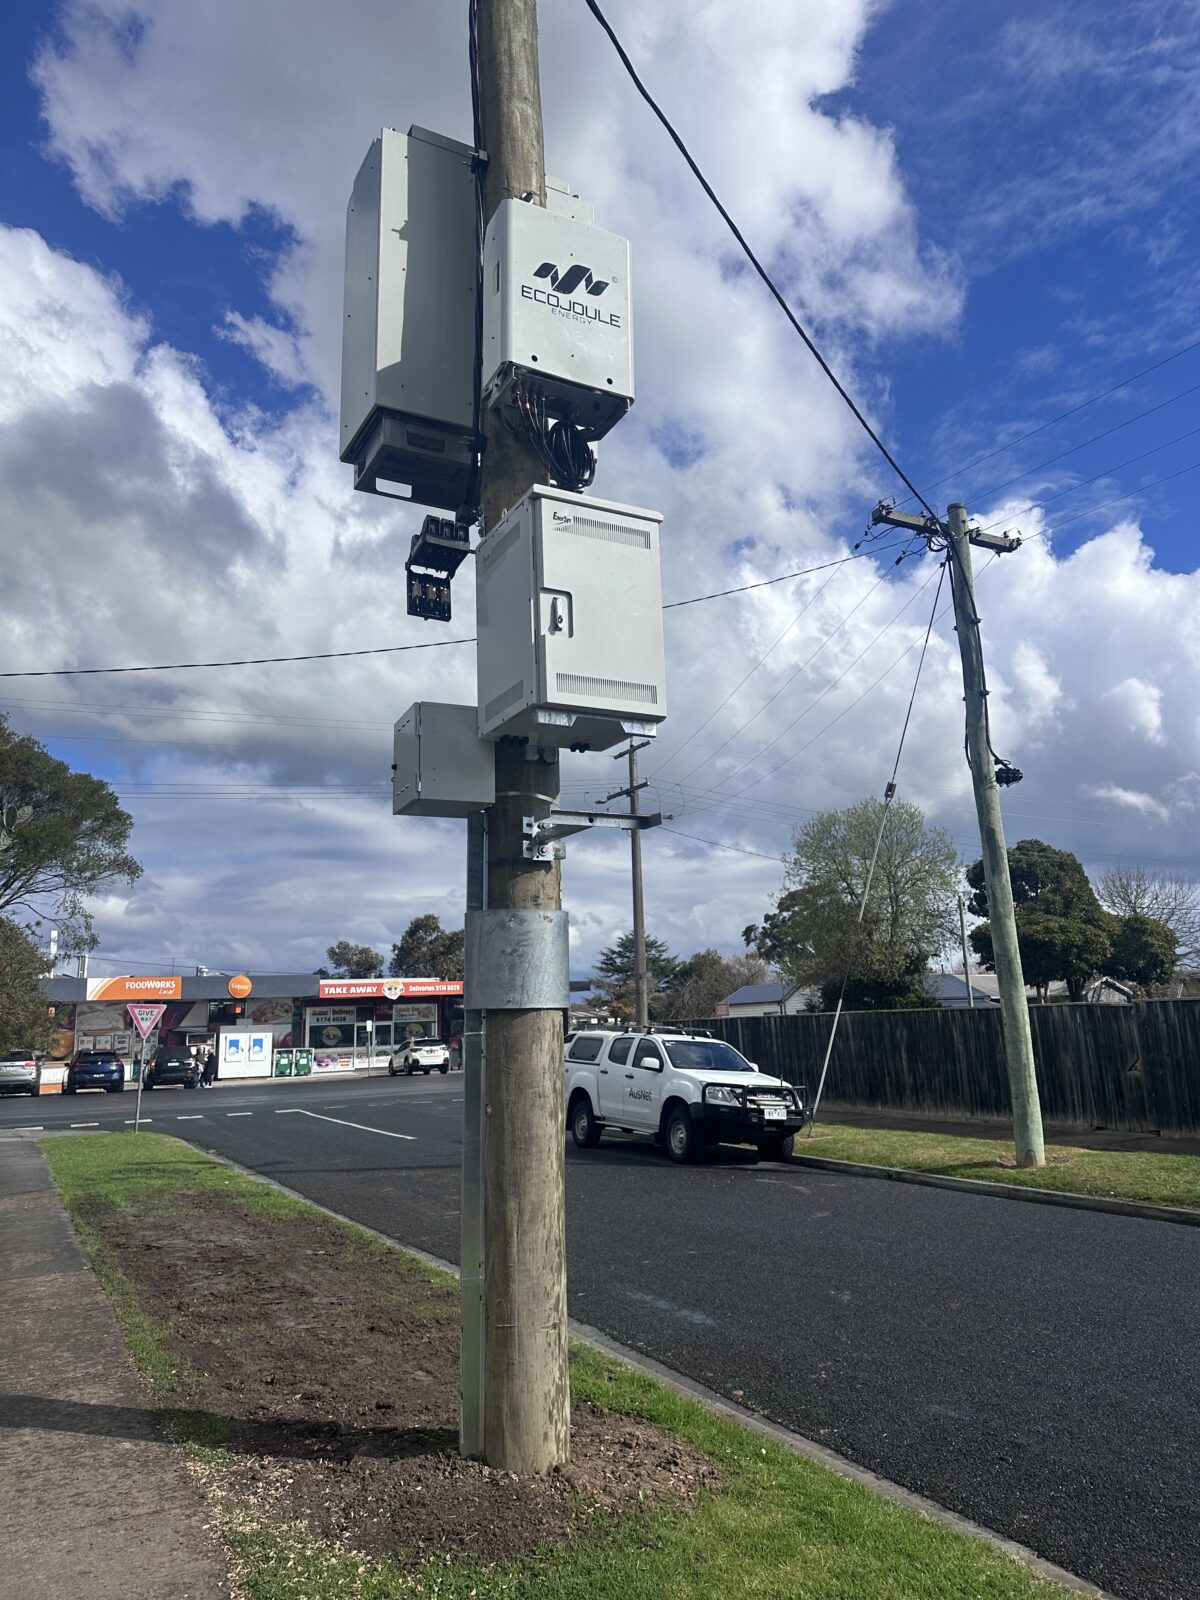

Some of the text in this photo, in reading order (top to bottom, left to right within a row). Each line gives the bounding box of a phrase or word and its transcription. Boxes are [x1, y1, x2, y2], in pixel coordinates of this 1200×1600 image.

[521, 284, 621, 328] ECOJOULE
[551, 307, 593, 325] ENERGY
[324, 985, 378, 994] TAKE AWAY
[138, 1009, 155, 1017] GIVE
[628, 1087, 652, 1102] AusNet
